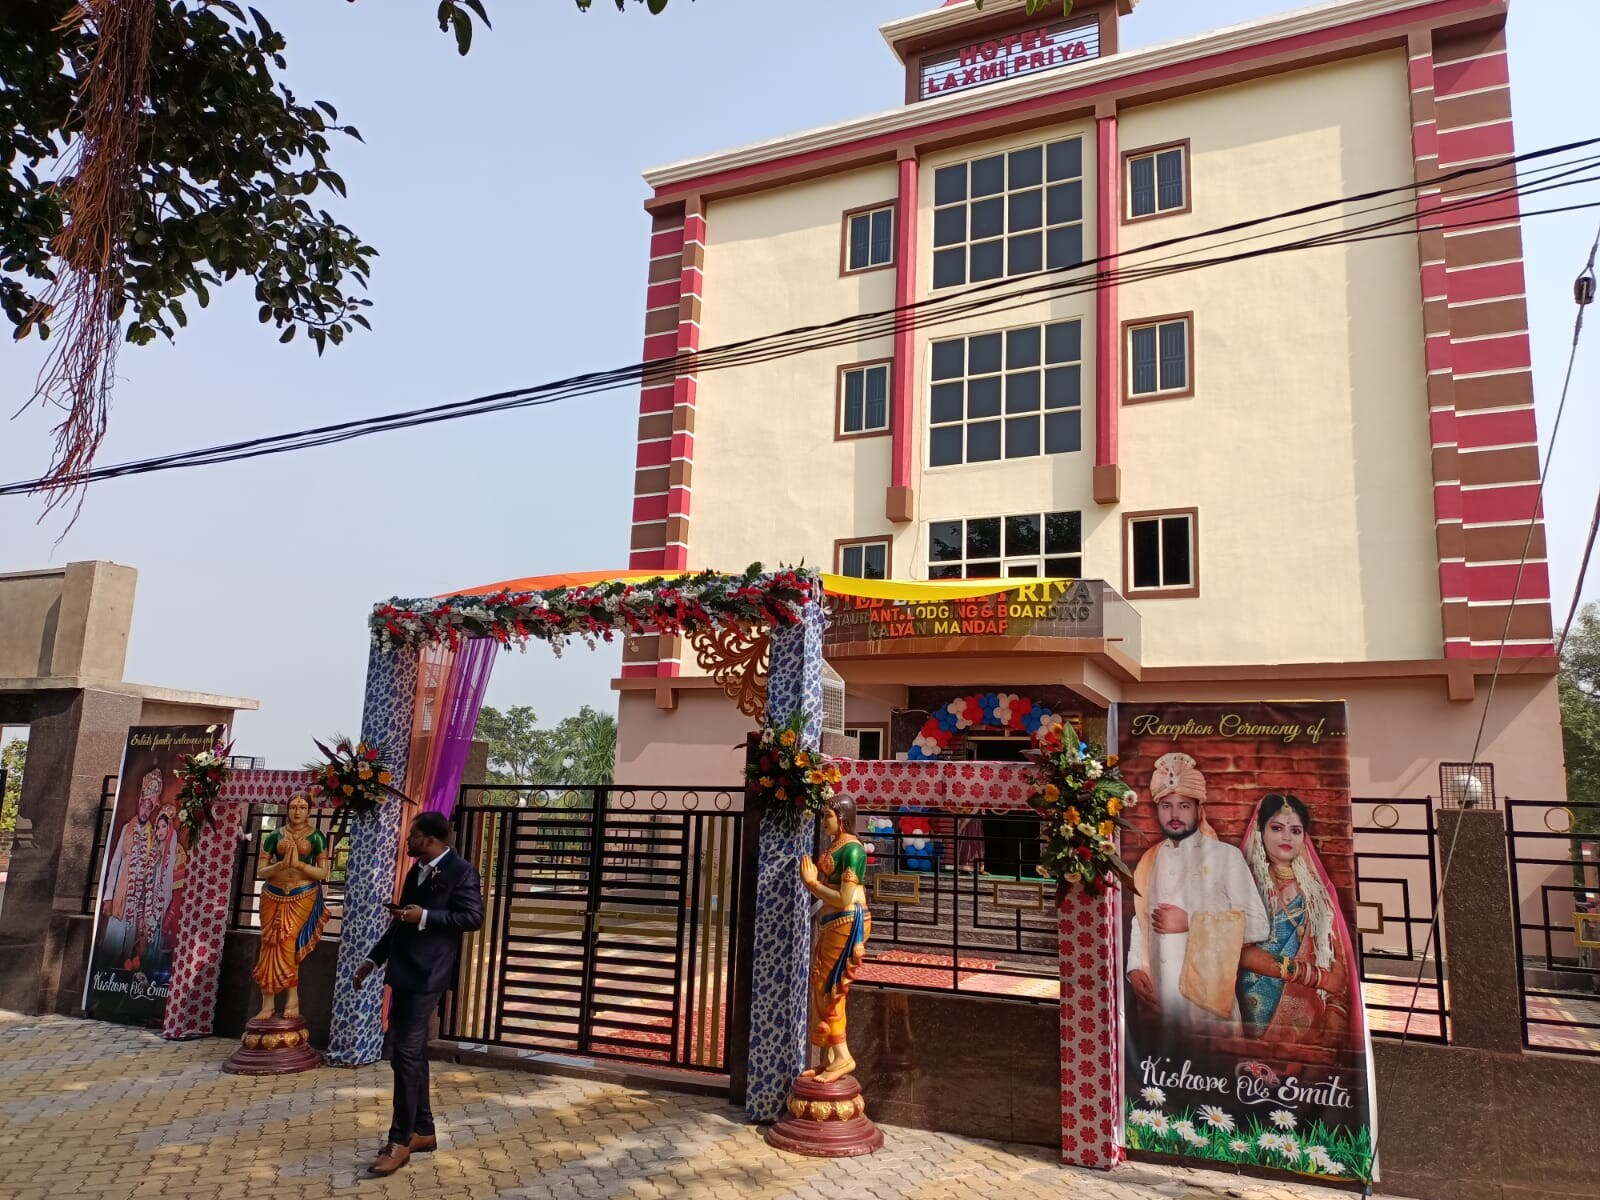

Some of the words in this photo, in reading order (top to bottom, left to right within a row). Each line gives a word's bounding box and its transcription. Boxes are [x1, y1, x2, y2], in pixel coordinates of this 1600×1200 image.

[959, 28, 1055, 67] HOTEL
[928, 60, 1006, 93] LAXMI
[1014, 41, 1088, 73] PRIYA
[981, 605, 994, 618] &
[998, 604, 1090, 621] BOARDING
[868, 620, 927, 638] KALYAN
[934, 619, 1008, 634] MANDAP
[1131, 714, 1213, 741] Reception
[1219, 713, 1301, 743] Ceremony
[1306, 718, 1326, 743] of
[93, 970, 129, 994] Kishore
[1140, 1055, 1231, 1094] Kishore
[1277, 1075, 1354, 1109] Smita
